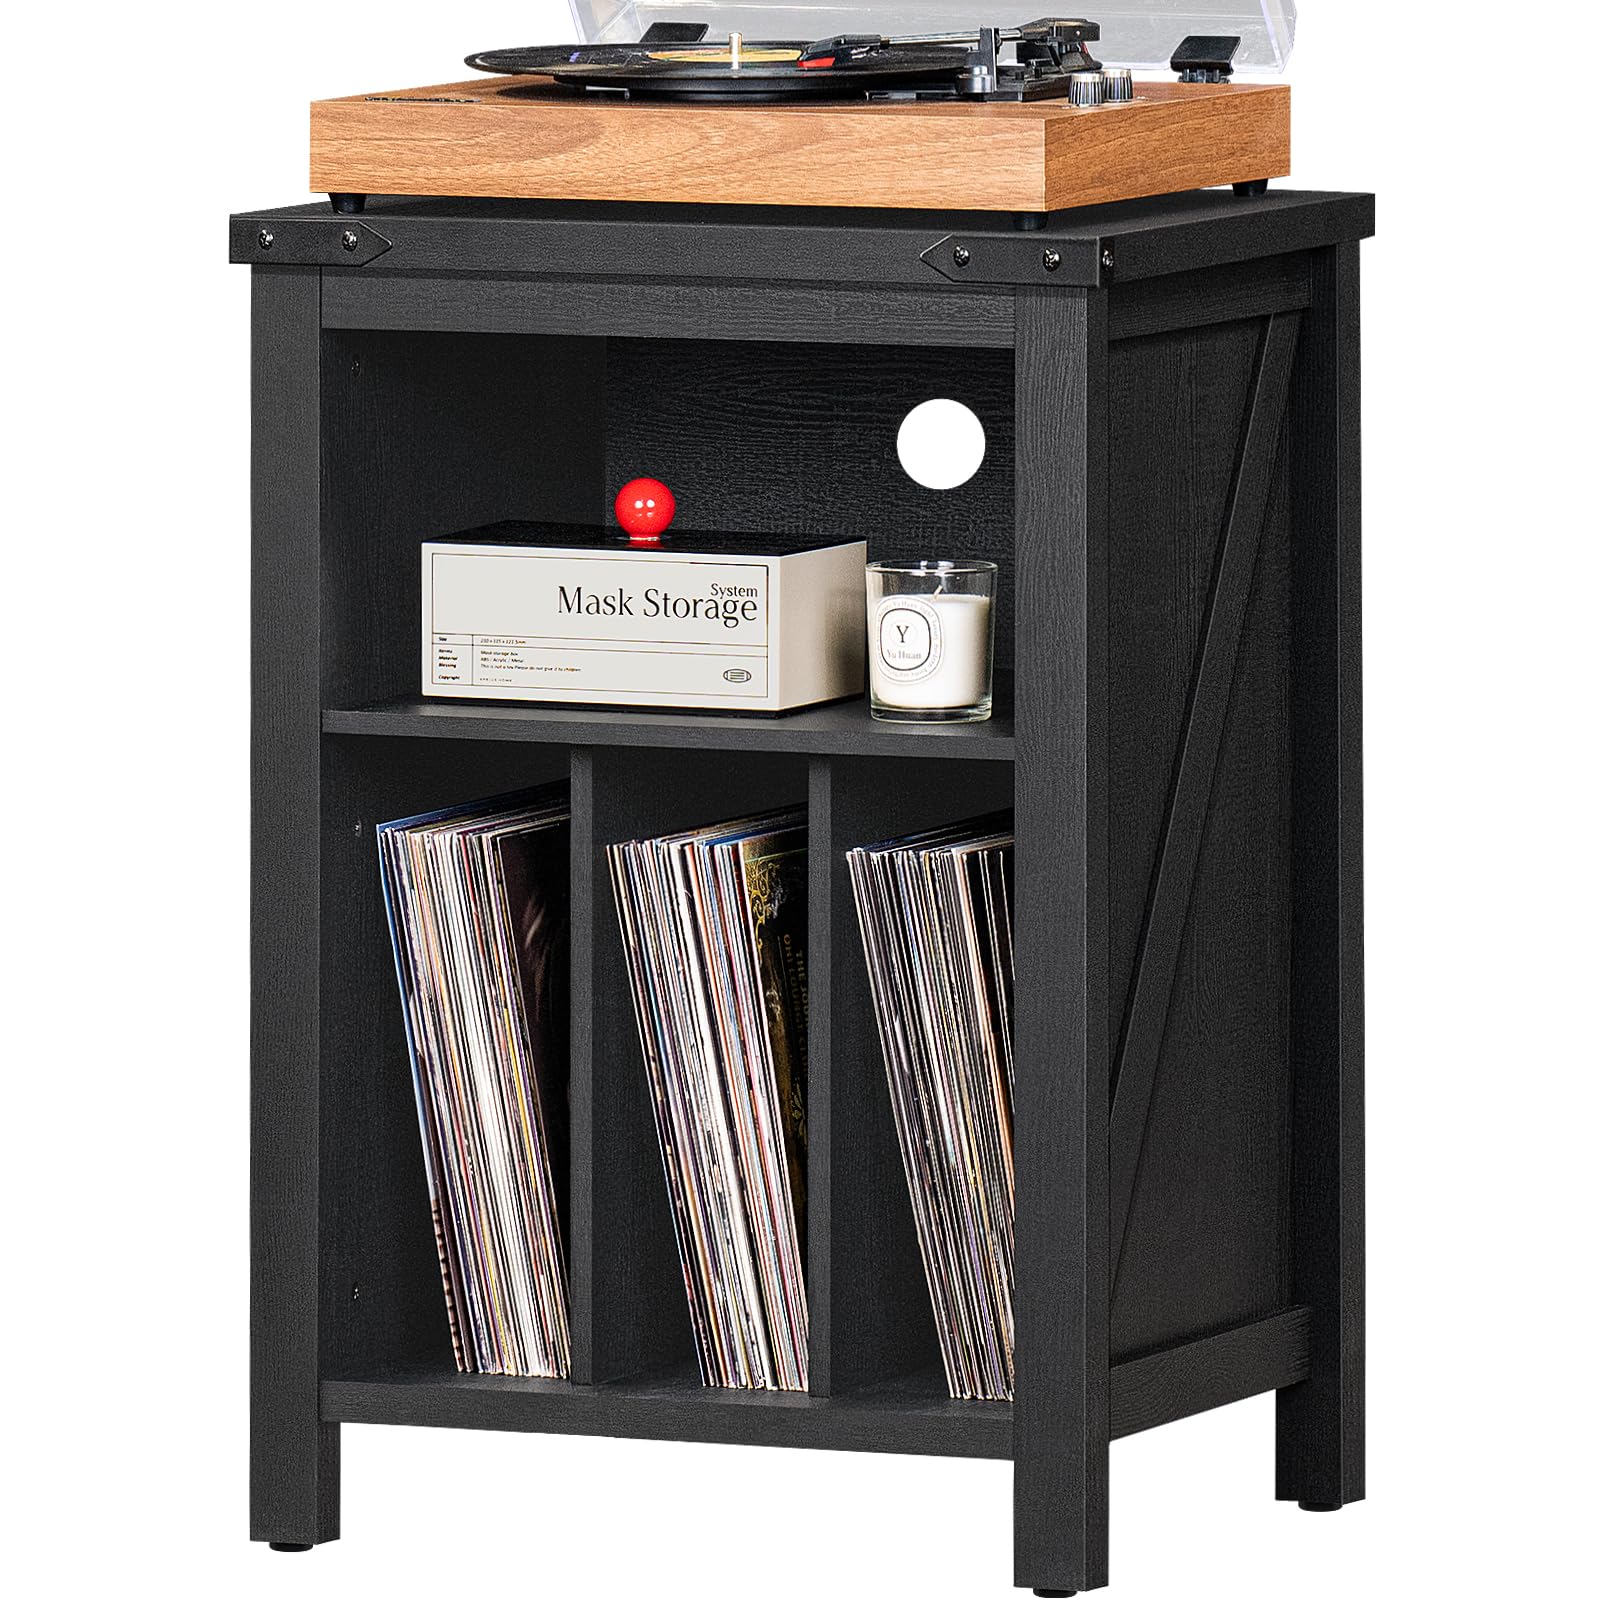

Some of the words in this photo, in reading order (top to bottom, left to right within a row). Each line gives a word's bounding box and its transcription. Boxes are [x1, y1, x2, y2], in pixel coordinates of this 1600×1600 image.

[710, 582, 758, 599] System
[558, 585, 634, 616] Mask
[643, 588, 758, 628] Storage
[896, 625, 909, 643] Y
